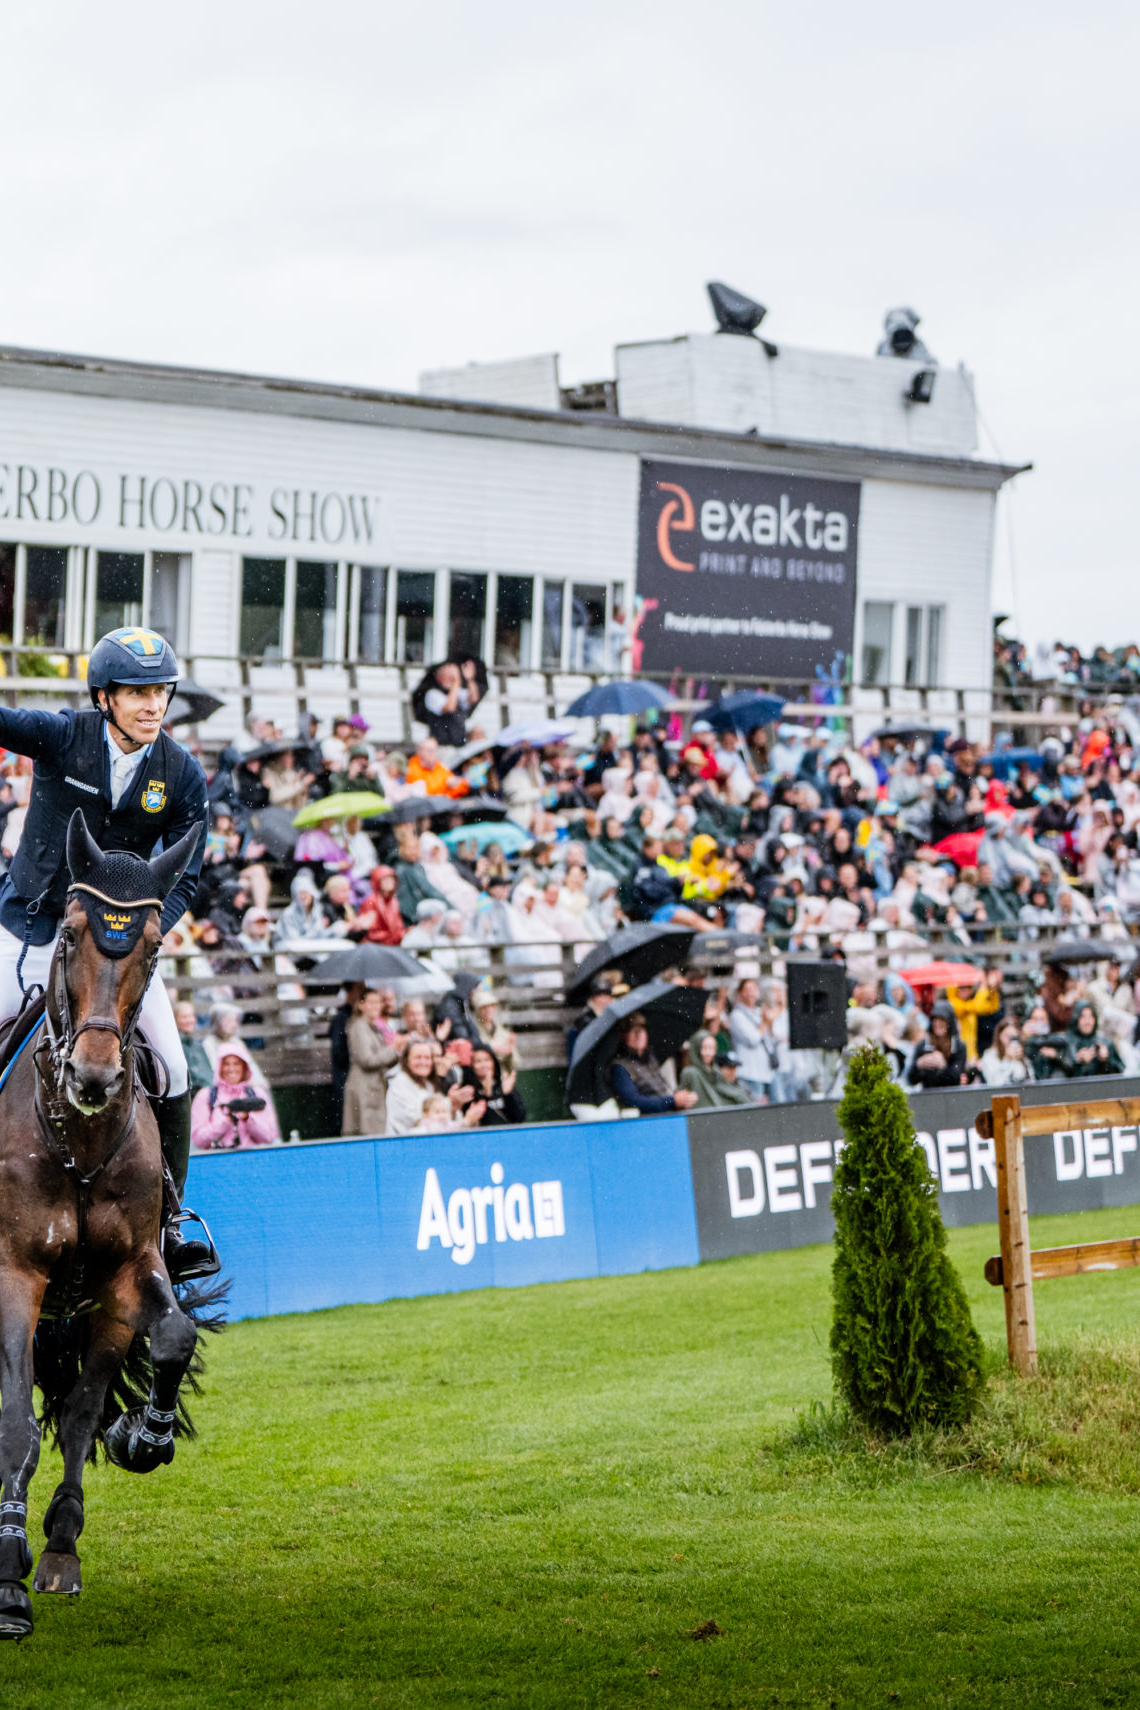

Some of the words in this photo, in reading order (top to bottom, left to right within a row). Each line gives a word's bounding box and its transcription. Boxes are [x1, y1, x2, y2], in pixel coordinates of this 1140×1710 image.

[118, 474, 254, 537] HORSE
[267, 487, 381, 545] SHOW
[700, 494, 849, 553] exakta
[699, 552, 746, 575] PRINT
[749, 555, 783, 579] AND
[786, 558, 845, 584] BEYOND
[105, 930, 128, 940] SWE
[725, 1127, 997, 1219] DEFER
[1053, 1124, 1140, 1182] DEF
[416, 1161, 534, 1266] Agria
